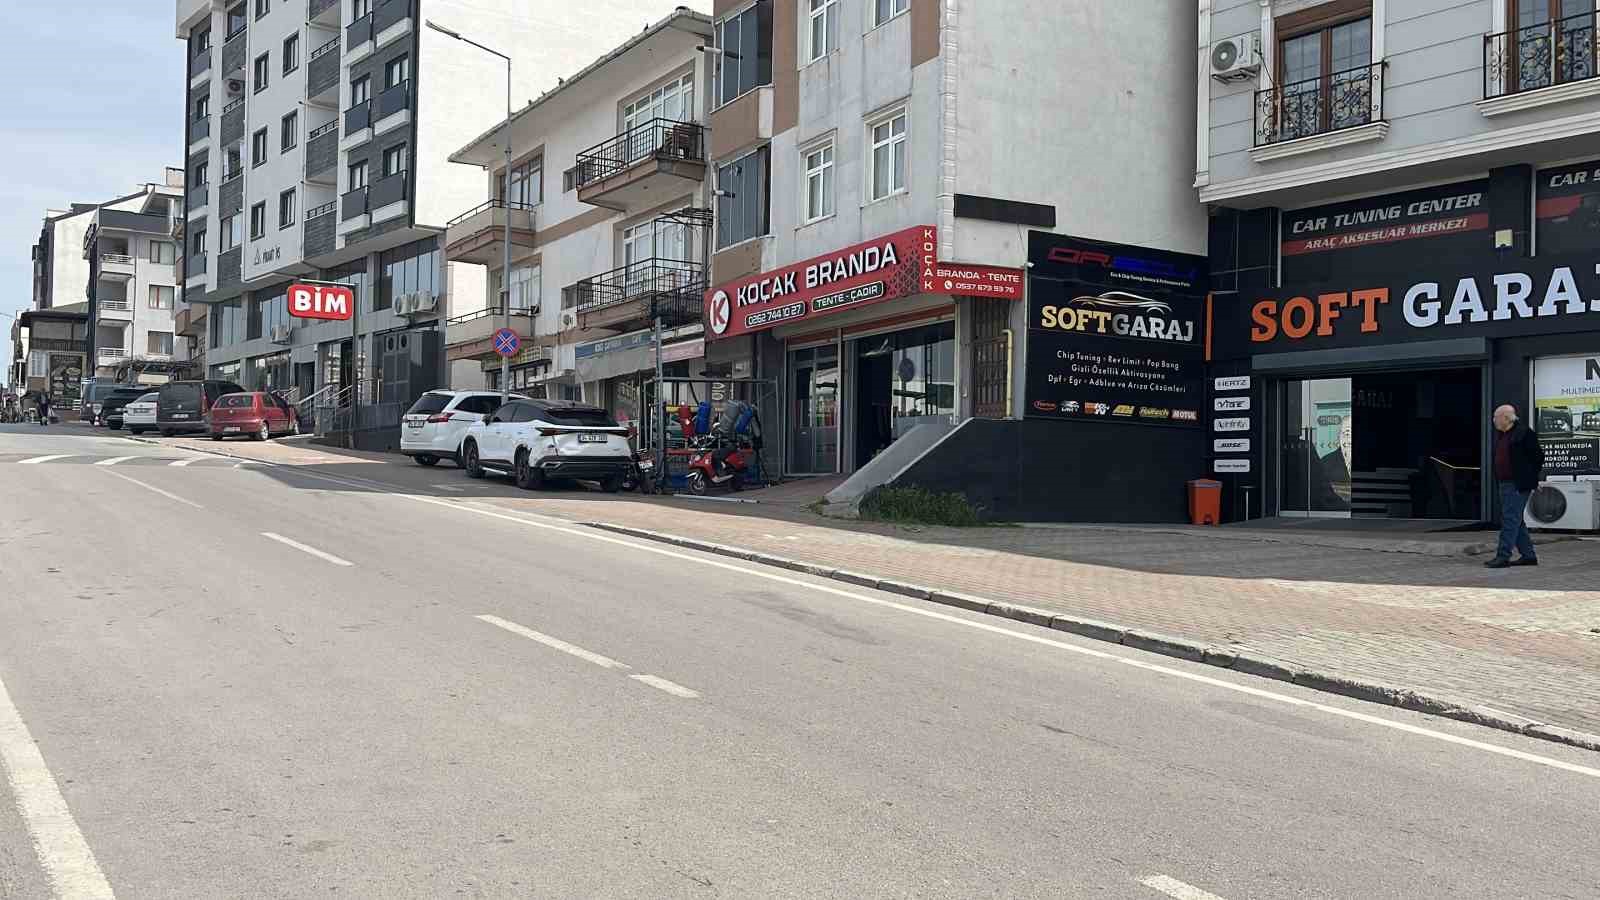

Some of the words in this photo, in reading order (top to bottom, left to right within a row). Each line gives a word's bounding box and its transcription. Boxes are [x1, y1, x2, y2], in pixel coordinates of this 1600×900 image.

[1548, 171, 1588, 188] CAR
[1293, 217, 1327, 234] CAR
[1334, 206, 1401, 228] TUNING
[1407, 192, 1482, 216] CENTER
[1304, 236, 1337, 250] ARAÇ
[1341, 227, 1407, 244] AKSESUAR
[737, 271, 797, 308] KOÇAK
[805, 242, 897, 289] BRANDA
[936, 269, 980, 280] BRANDA
[987, 272, 1021, 283] TENTE
[293, 286, 347, 315] BİM
[816, 293, 844, 309] TENTE
[850, 284, 879, 303] ÇADIR
[1041, 305, 1194, 342] SOFTGARAJ
[1251, 288, 1389, 342] SOFT
[1057, 350, 1075, 361] Chip
[1077, 352, 1101, 364] Tuning
